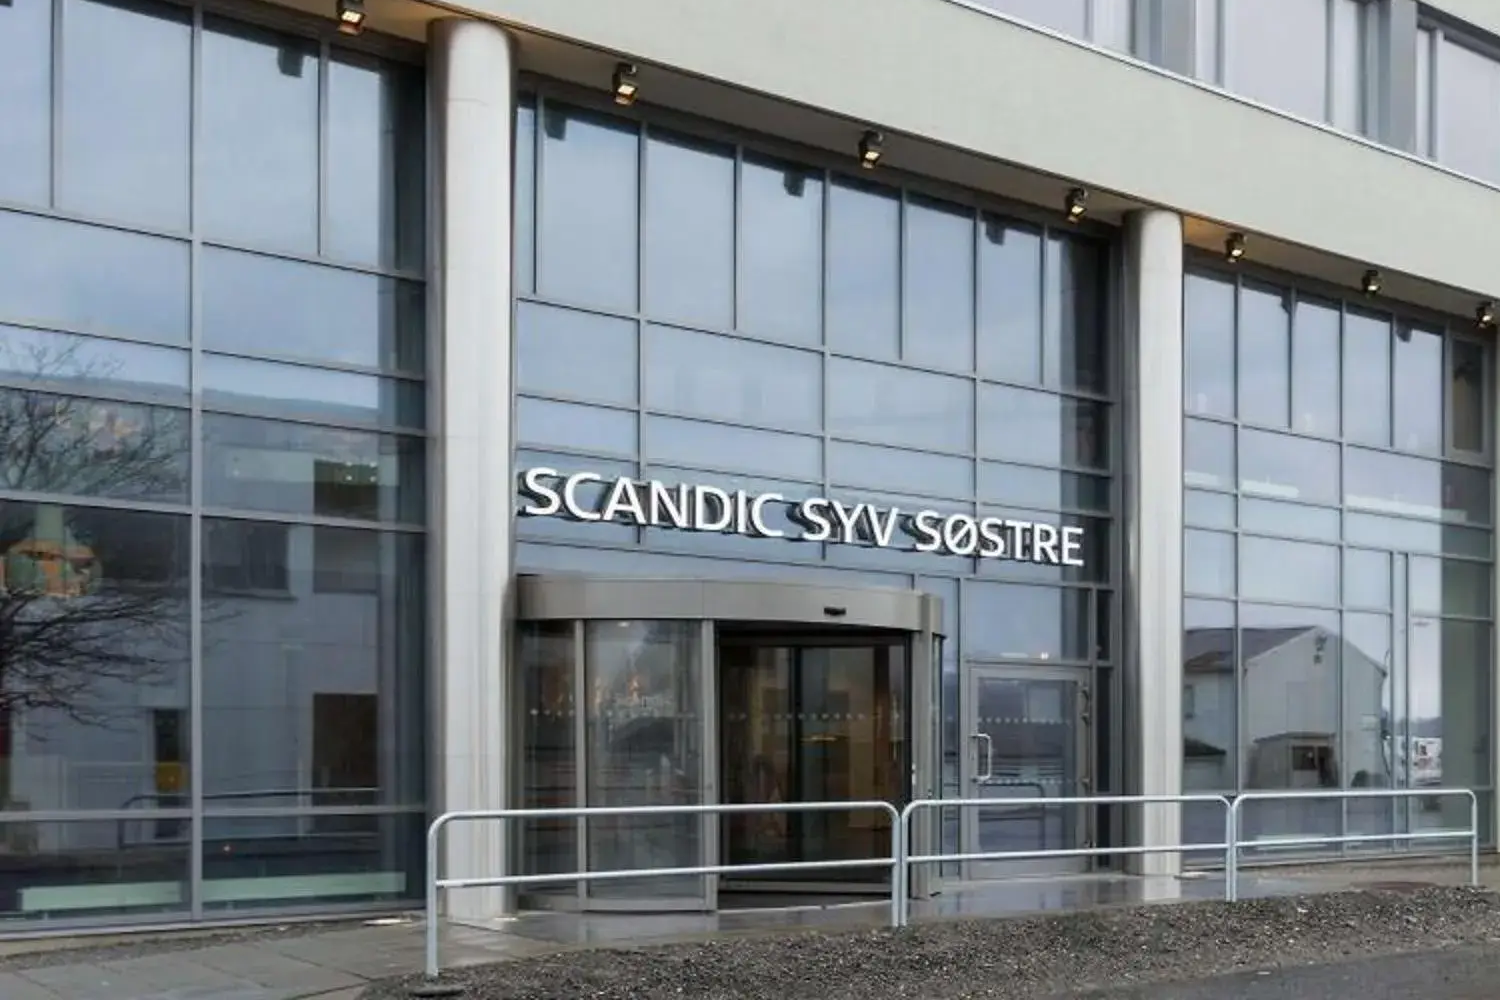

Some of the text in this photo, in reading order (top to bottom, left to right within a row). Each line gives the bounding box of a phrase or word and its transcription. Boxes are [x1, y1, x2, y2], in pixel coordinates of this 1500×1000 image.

[522, 466, 1085, 566] SCANDIC SYV SØSTRE
